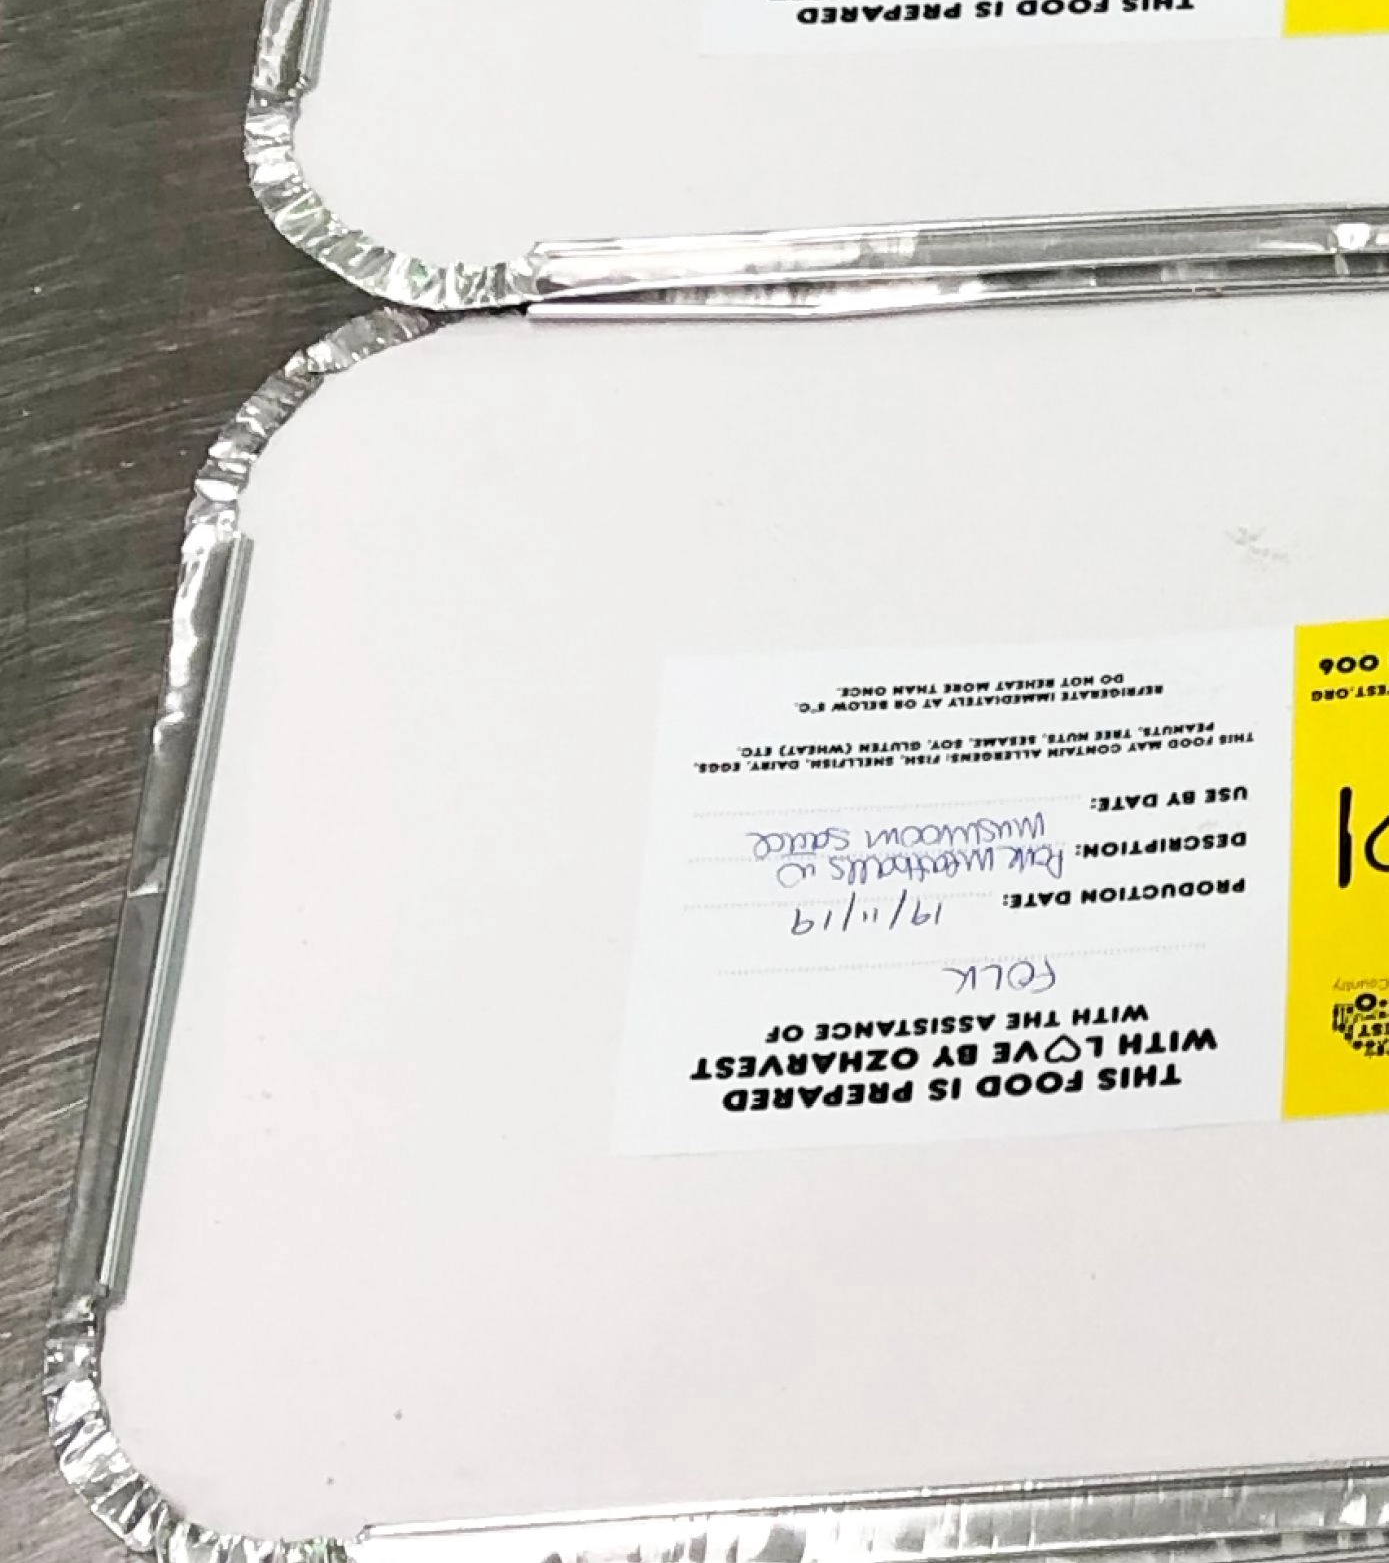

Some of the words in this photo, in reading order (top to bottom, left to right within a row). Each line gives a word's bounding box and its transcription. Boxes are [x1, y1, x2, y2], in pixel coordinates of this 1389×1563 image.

[797, 2, 962, 24] PREPARED
[975, 1, 1003, 18] IS
[1319, 655, 1379, 675] 006
[944, 682, 990, 693] MORE
[995, 678, 1055, 691] REHEAT
[1060, 676, 1094, 688] NOT
[1100, 673, 1124, 685] DO
[842, 686, 887, 697] ONCE.
[893, 684, 937, 695] THAN
[1062, 685, 1163, 701] REFRIGERATE
[831, 700, 888, 712] BELOW
[894, 699, 917, 709] OR
[923, 698, 942, 709] AT
[948, 692, 1055, 707] IMMEDIATELY
[1091, 793, 1158, 812] DATE:
[1167, 790, 1195, 806] BY
[1205, 786, 1248, 803] USE
[1076, 832, 1246, 858] DESCRIPTION:
[1003, 891, 1071, 908] DATE:
[1081, 878, 1245, 904] PRODUCTION
[791, 889, 941, 936] 19/11/19
[942, 958, 1056, 994] FOLK
[1333, 978, 1389, 993] Country
[1006, 1010, 1060, 1030] THE
[1072, 1004, 1149, 1026] WITH
[765, 1025, 804, 1043] OF
[815, 1014, 996, 1041] ASSISTANCE
[1119, 1028, 1218, 1055] WITH
[690, 1047, 919, 1080] OZHARVEST
[932, 1044, 978, 1068] BY
[976, 1070, 1083, 1098] FOOD
[1098, 1063, 1182, 1091] THIS
[723, 1080, 913, 1112] PREPARED
[928, 1077, 961, 1101] IS
